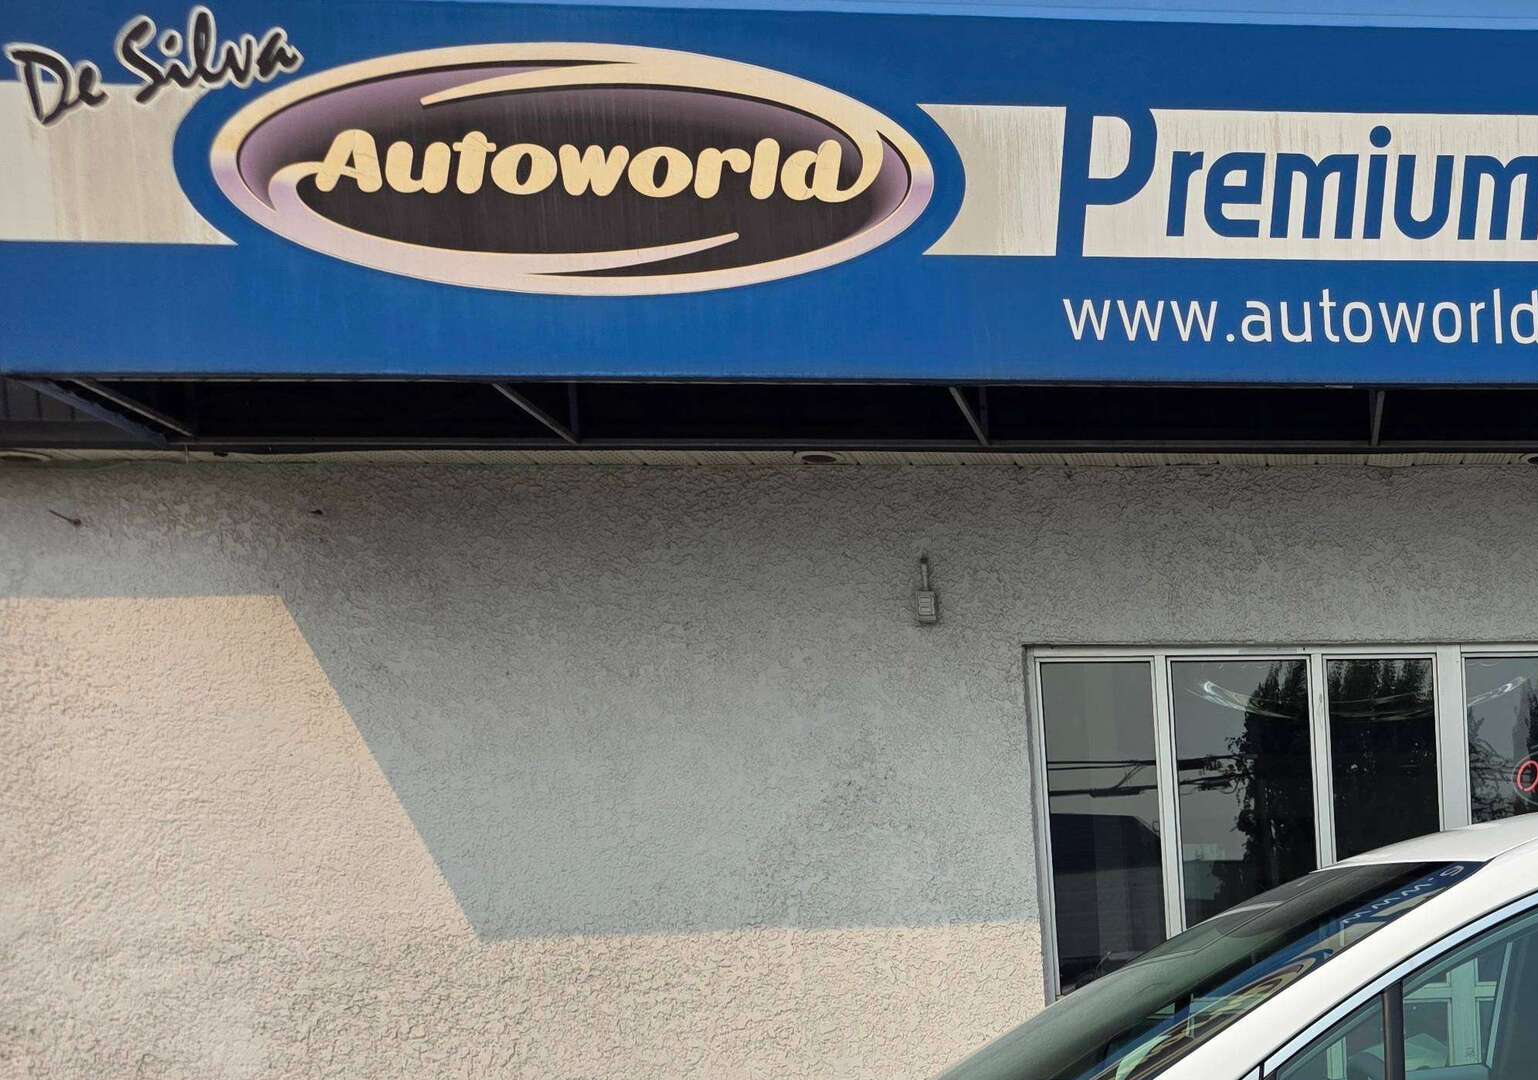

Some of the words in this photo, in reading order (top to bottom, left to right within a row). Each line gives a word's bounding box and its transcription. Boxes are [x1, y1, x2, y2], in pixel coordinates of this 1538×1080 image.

[8, 47, 107, 125] De
[119, 9, 301, 104] Silva
[313, 128, 866, 203] Autoworld
